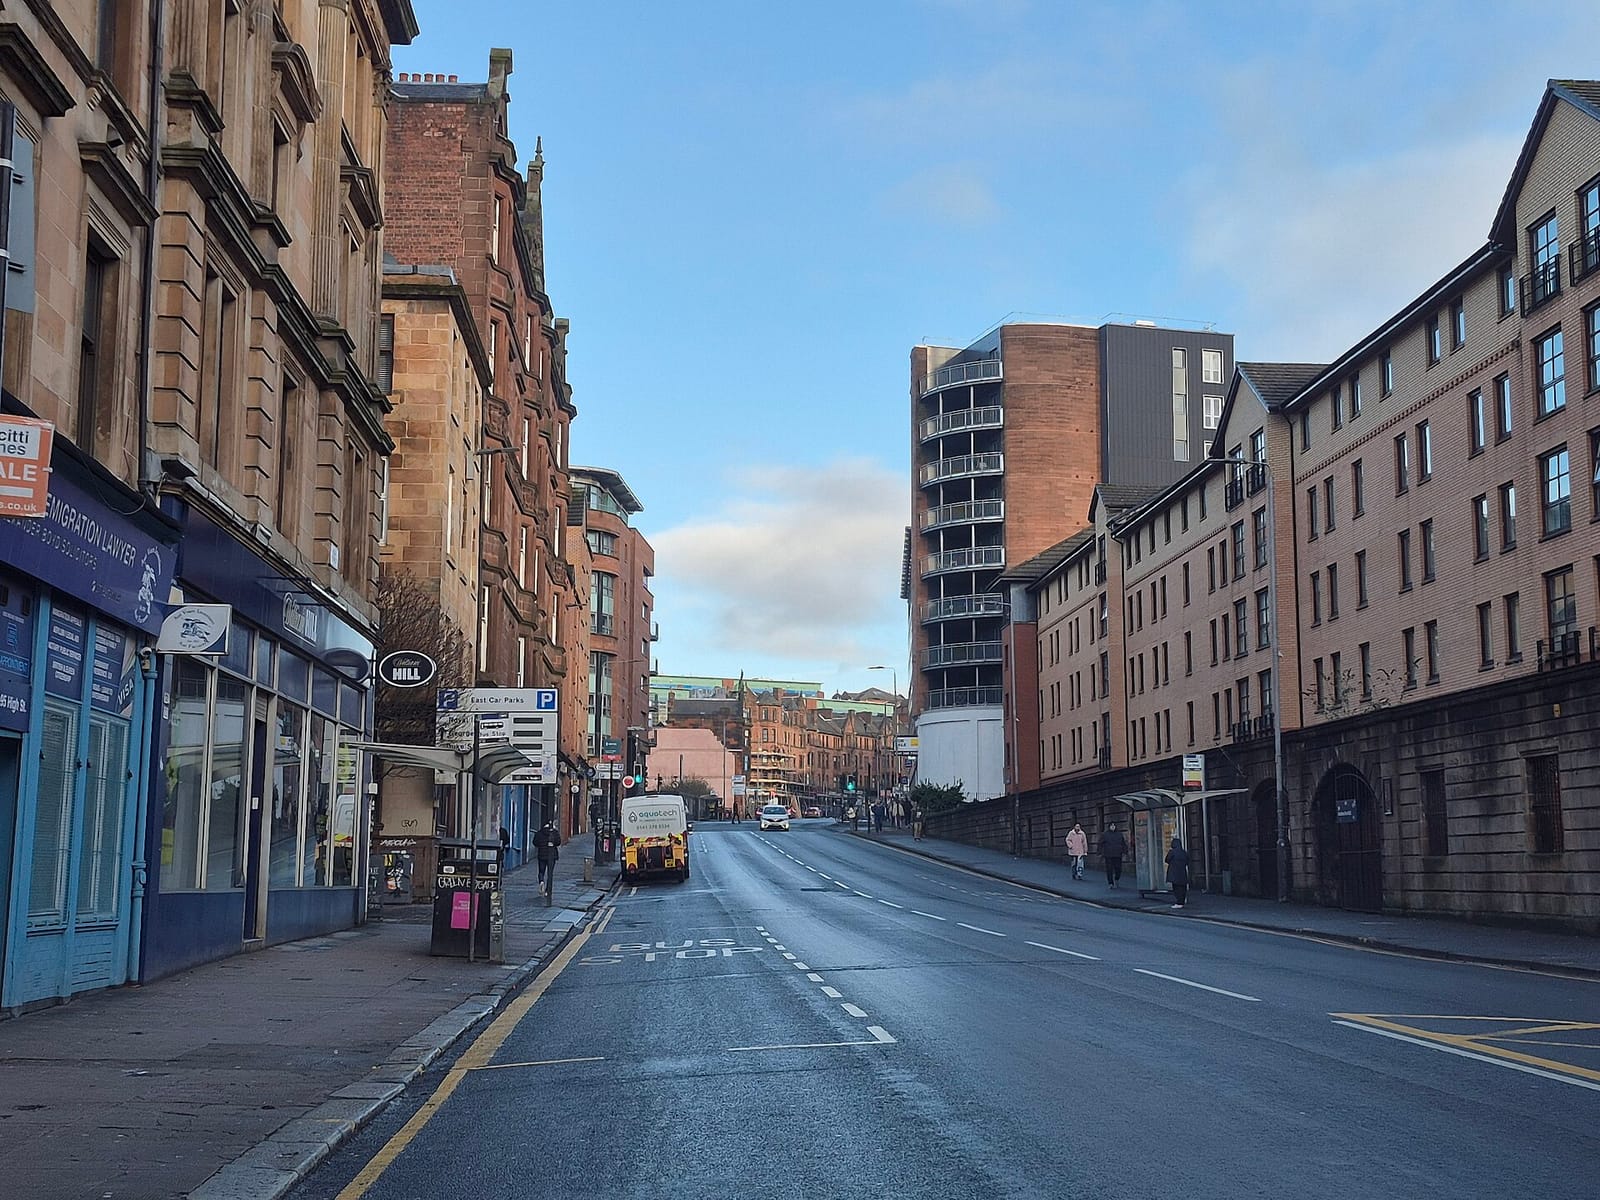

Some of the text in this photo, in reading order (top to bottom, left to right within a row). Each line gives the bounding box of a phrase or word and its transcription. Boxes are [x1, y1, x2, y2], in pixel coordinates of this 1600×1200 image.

[0, 428, 29, 444] citti
[102, 530, 137, 568] LAWYER
[392, 667, 421, 680] HILL
[117, 677, 134, 706] VISA
[471, 696, 487, 704] East
[488, 696, 502, 704] Car
[504, 696, 525, 704] Parks
[638, 808, 678, 819] aquatech
[609, 938, 736, 953] BUS
[578, 946, 763, 967] STOP
